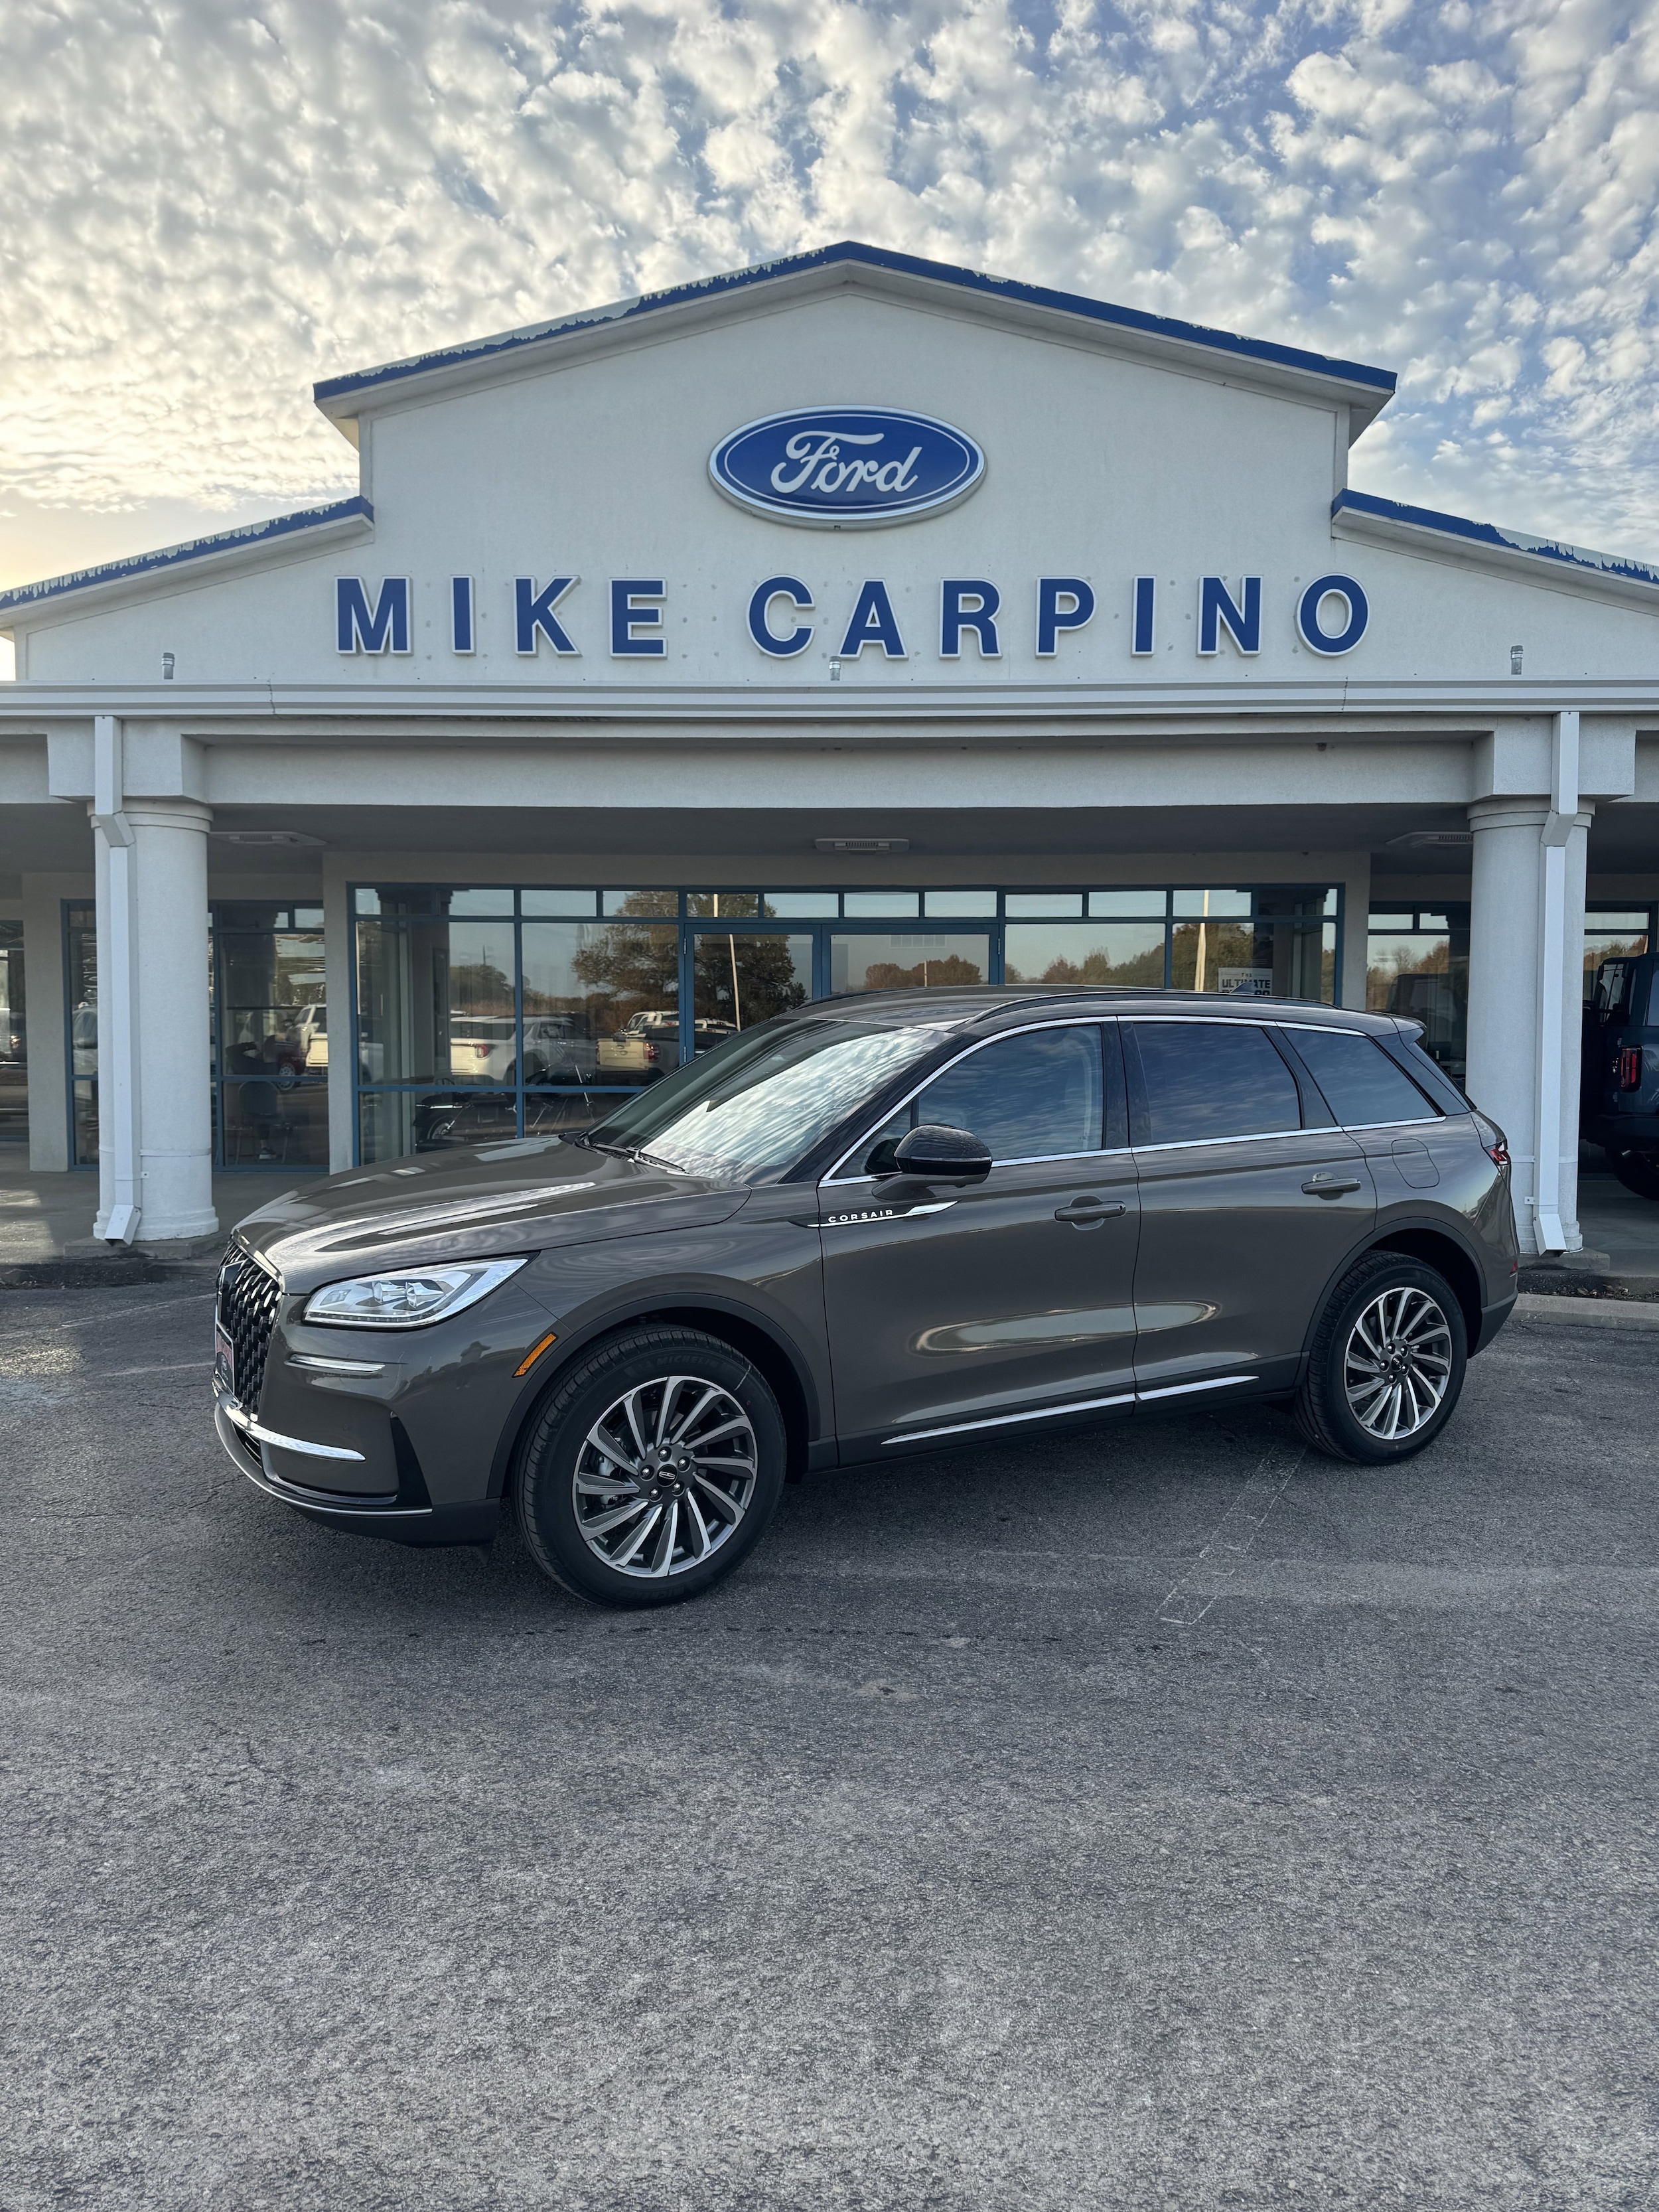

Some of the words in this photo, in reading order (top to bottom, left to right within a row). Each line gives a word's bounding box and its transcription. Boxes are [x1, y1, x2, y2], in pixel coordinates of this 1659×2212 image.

[771, 431, 922, 493] Ford
[334, 575, 667, 657] MIKE
[747, 573, 1370, 660] CARPINO
[1222, 979, 1271, 988] ULTATE
[828, 1209, 893, 1222] CORSAIR
[656, 1355, 719, 1368] MICHELIN
